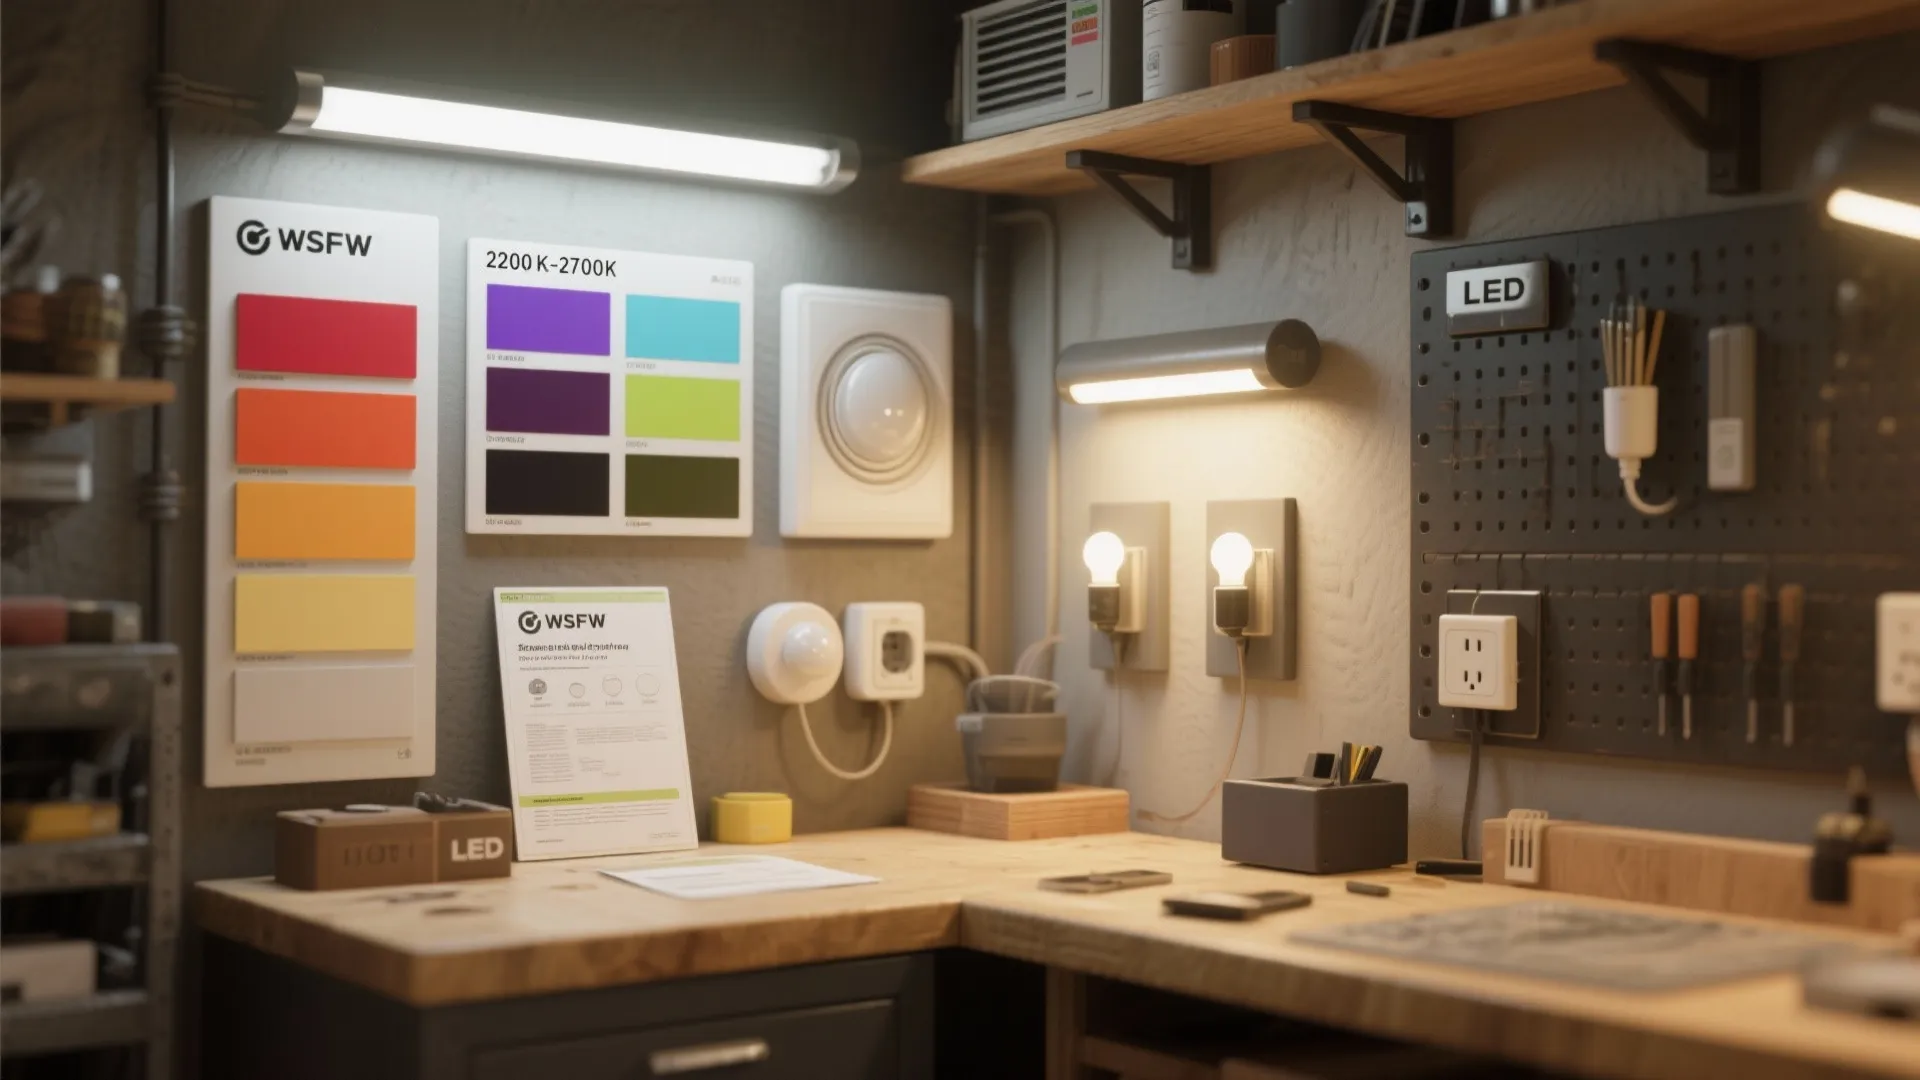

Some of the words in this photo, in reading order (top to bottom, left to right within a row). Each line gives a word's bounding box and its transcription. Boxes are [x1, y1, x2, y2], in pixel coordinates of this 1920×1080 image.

[278, 227, 373, 257] WSFW
[1464, 277, 1525, 305] LED
[544, 613, 606, 630] WSFW
[451, 836, 505, 862] LED
